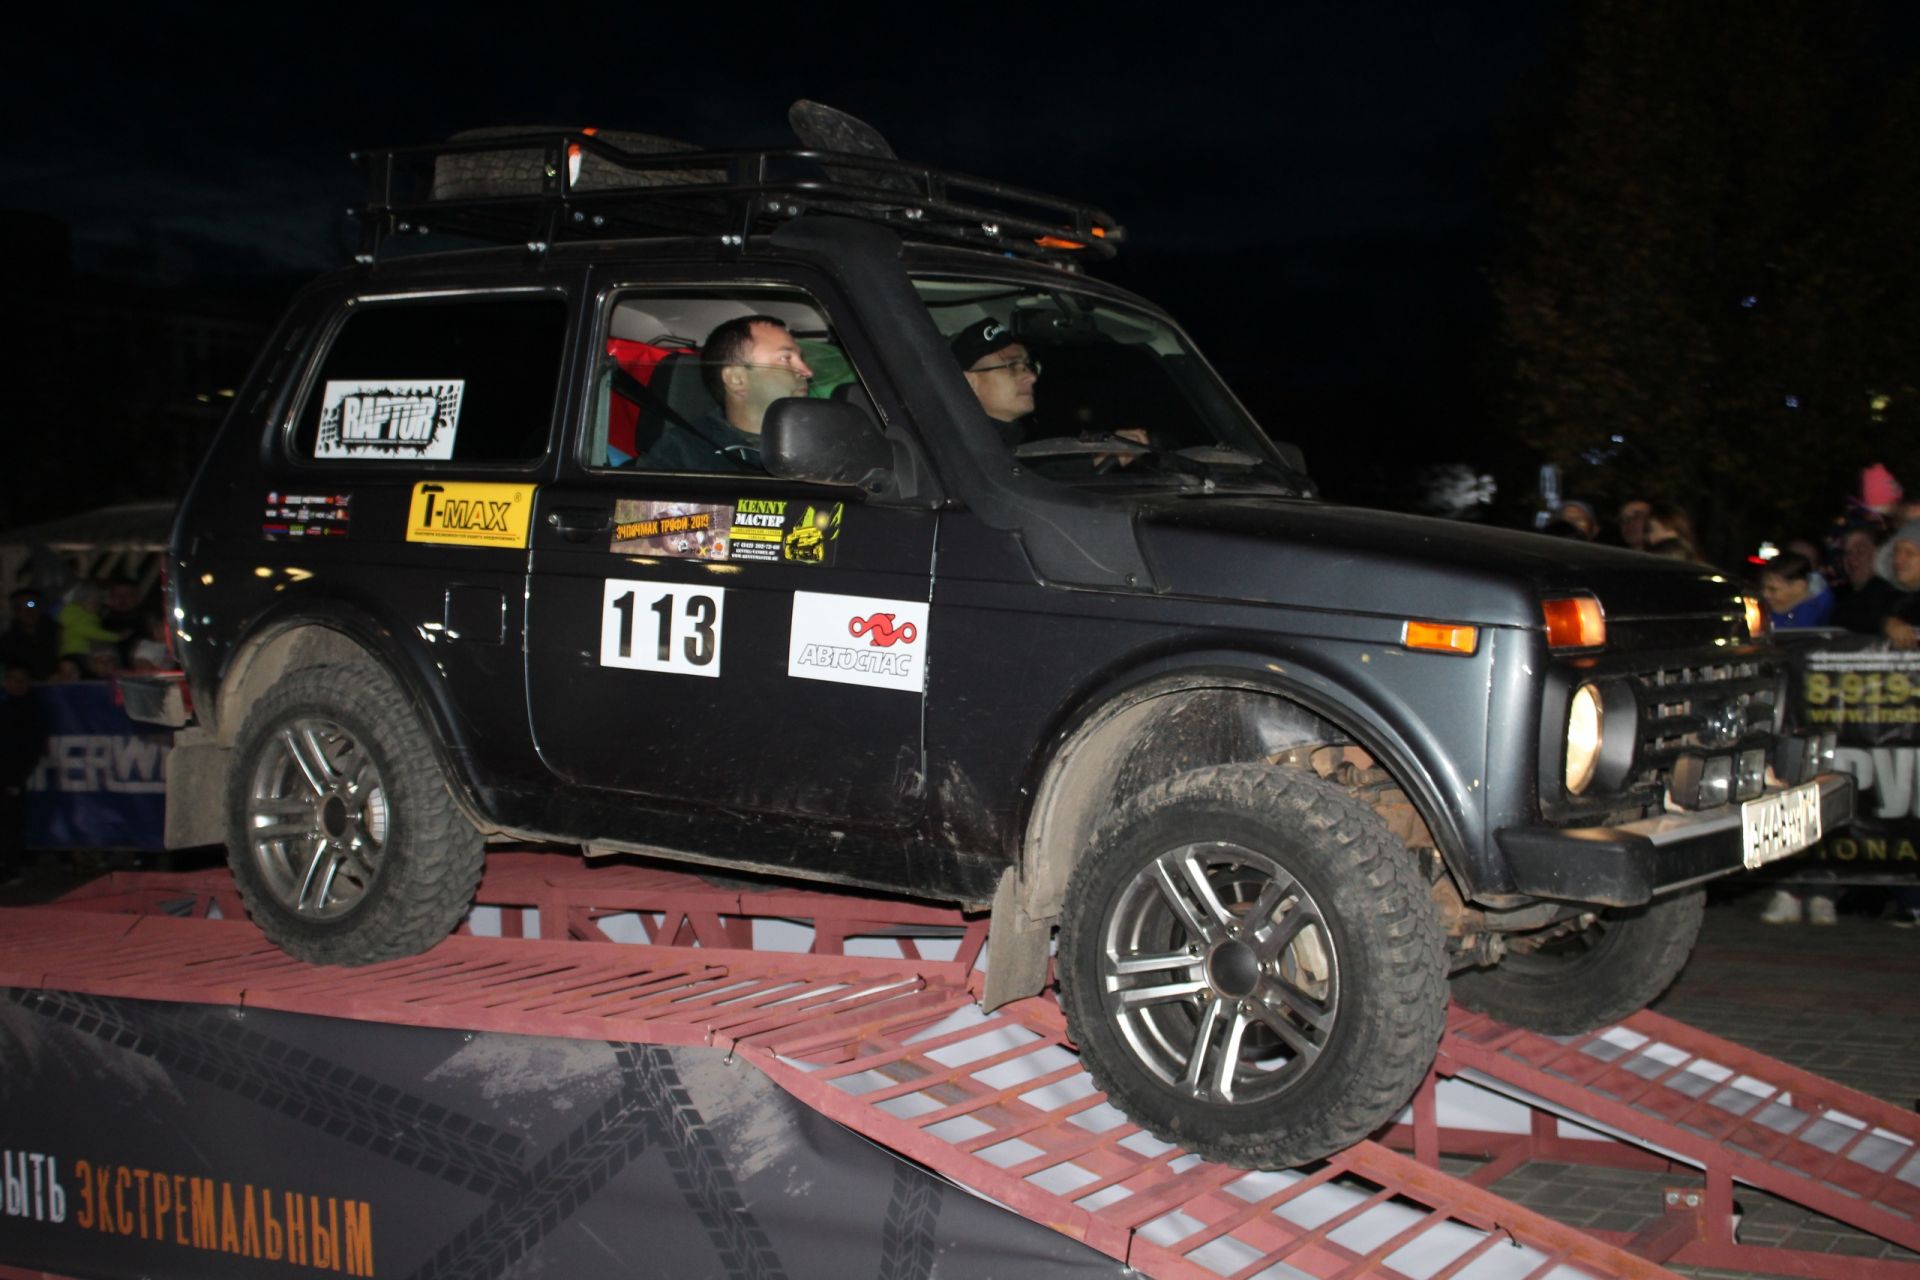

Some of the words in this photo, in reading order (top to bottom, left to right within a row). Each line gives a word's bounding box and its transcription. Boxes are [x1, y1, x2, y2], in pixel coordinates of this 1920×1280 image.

[342, 396, 437, 440] RAPTOR
[421, 484, 511, 532] T-MAX
[660, 517, 688, 533] ТРОФИ
[691, 513, 709, 528] 2019
[735, 513, 785, 528] МАСТЕР
[737, 499, 787, 515] KENNY
[613, 590, 717, 667] 113
[798, 644, 912, 677] АВТОСПАС
[0, 1149, 67, 1224] ЫТЬ
[75, 1159, 375, 1278] ЭКСТРЕМАЛЬНЫМ
